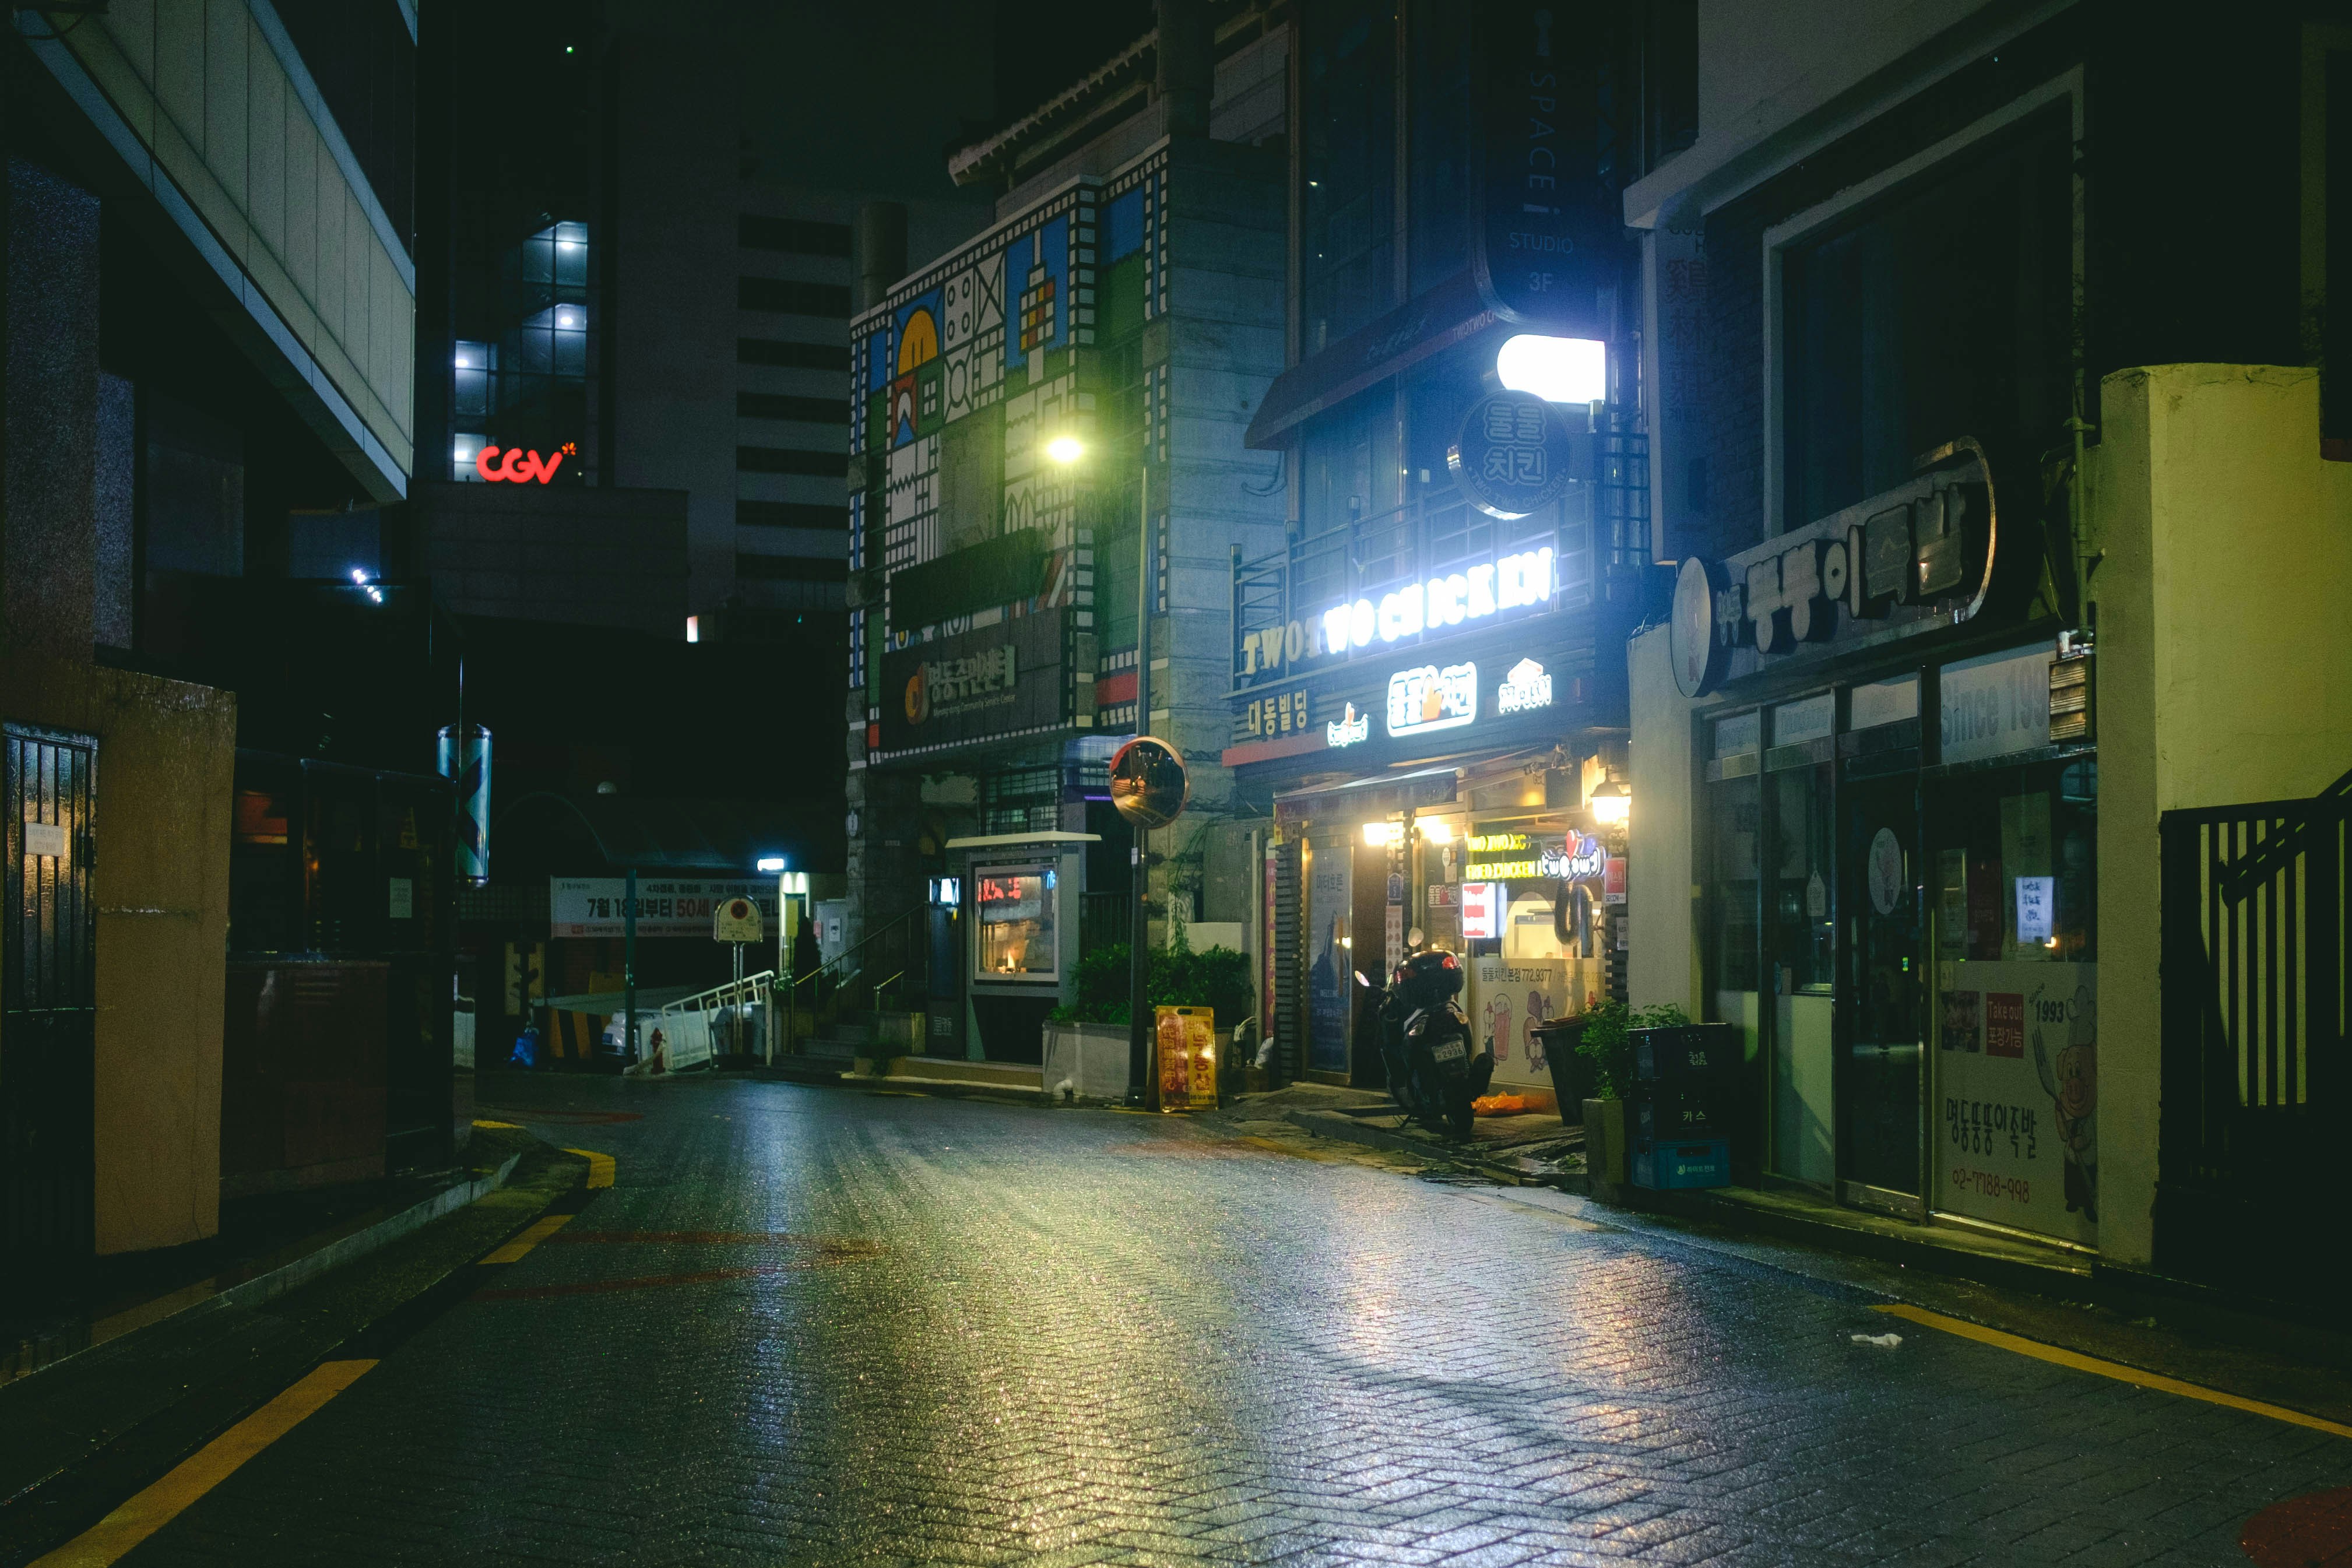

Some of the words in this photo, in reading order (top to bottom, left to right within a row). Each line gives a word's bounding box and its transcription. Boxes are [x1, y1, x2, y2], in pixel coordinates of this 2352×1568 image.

[1510, 234, 1574, 254] STUDIO
[1529, 272, 1553, 292] 3F
[1452, 313, 1485, 340] TWOTWO
[1489, 406, 1542, 438] 둘둘
[476, 445, 564, 484] CGV
[1488, 451, 1542, 481] 치킨
[1522, 473, 1565, 506] CHICKEN
[1377, 546, 1553, 642] CHICKEN
[2005, 660, 2046, 732] 199
[1248, 688, 1308, 736] 대동빌딩
[1493, 861, 1535, 878] CHICKEN
[587, 897, 610, 918] 7월
[676, 898, 709, 917] 50세
[1507, 967, 1521, 982] 본점
[2029, 982, 2046, 1006] since
[1988, 1000, 2008, 1020] Take
[2009, 1003, 2023, 1021] out
[2035, 1000, 2065, 1023] 1993
[1988, 1025, 2023, 1049] 포장가능
[1952, 1168, 2030, 1204] 02-7788-998
